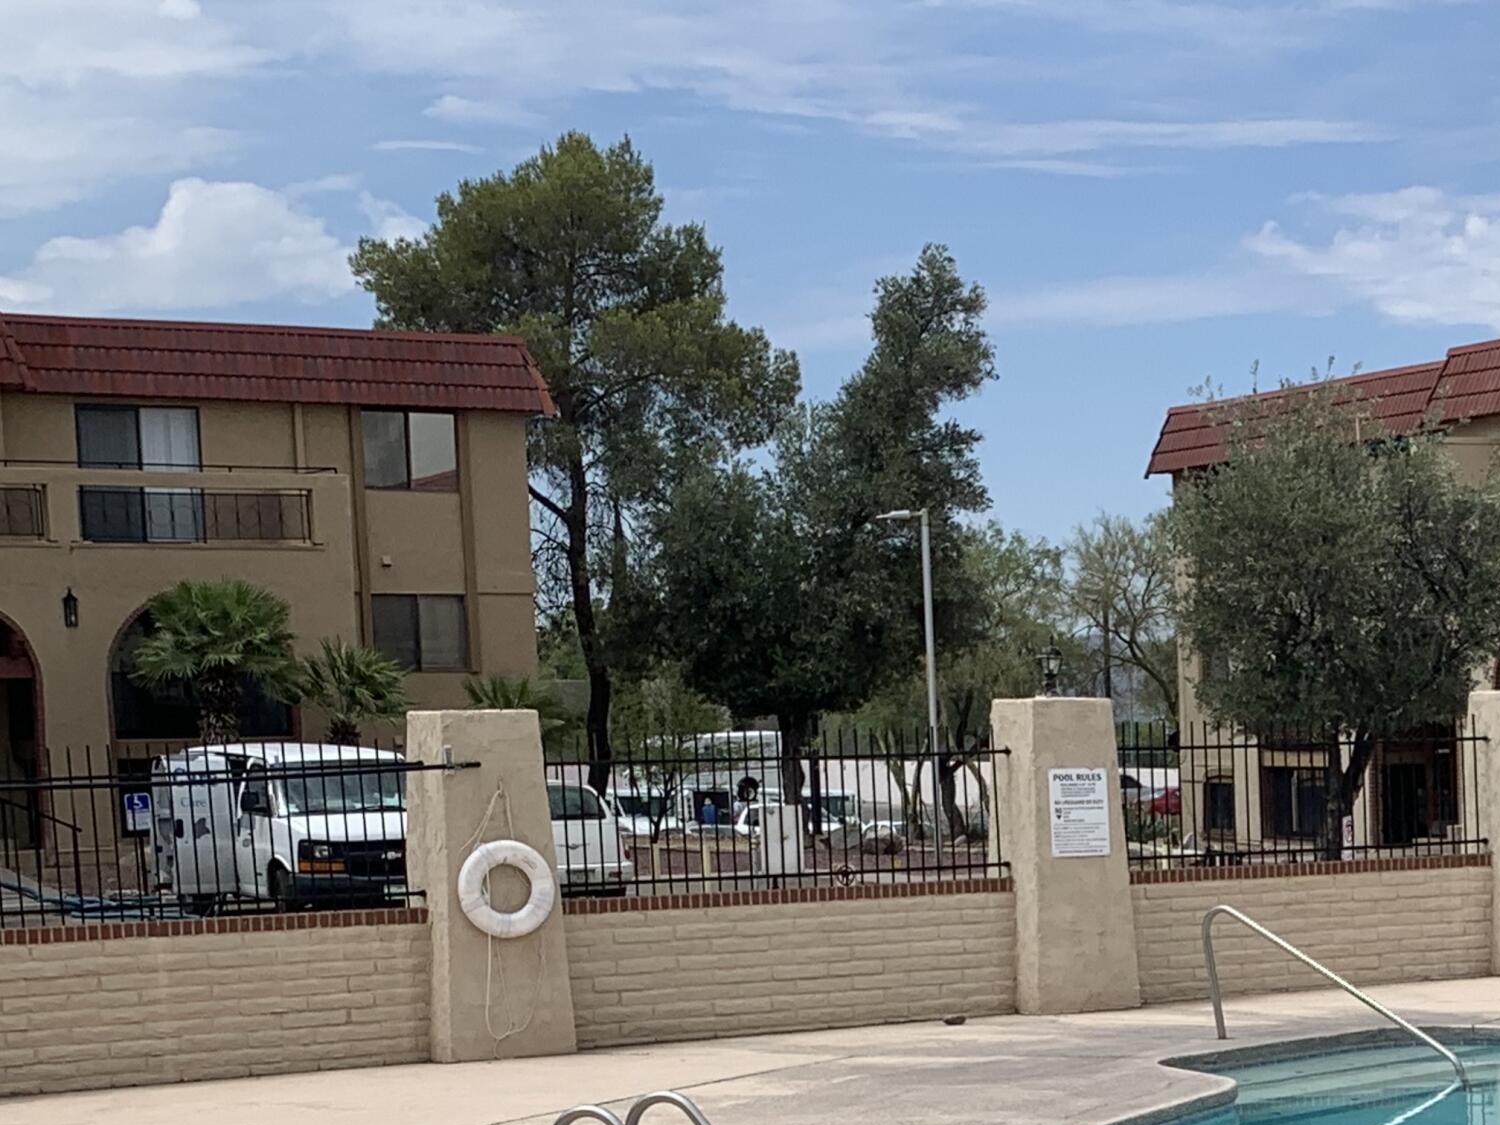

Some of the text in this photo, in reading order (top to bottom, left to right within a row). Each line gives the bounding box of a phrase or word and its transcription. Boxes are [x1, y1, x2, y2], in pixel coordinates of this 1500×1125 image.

[1053, 773, 1102, 781] POOL RULES
[180, 796, 208, 808] Cre
